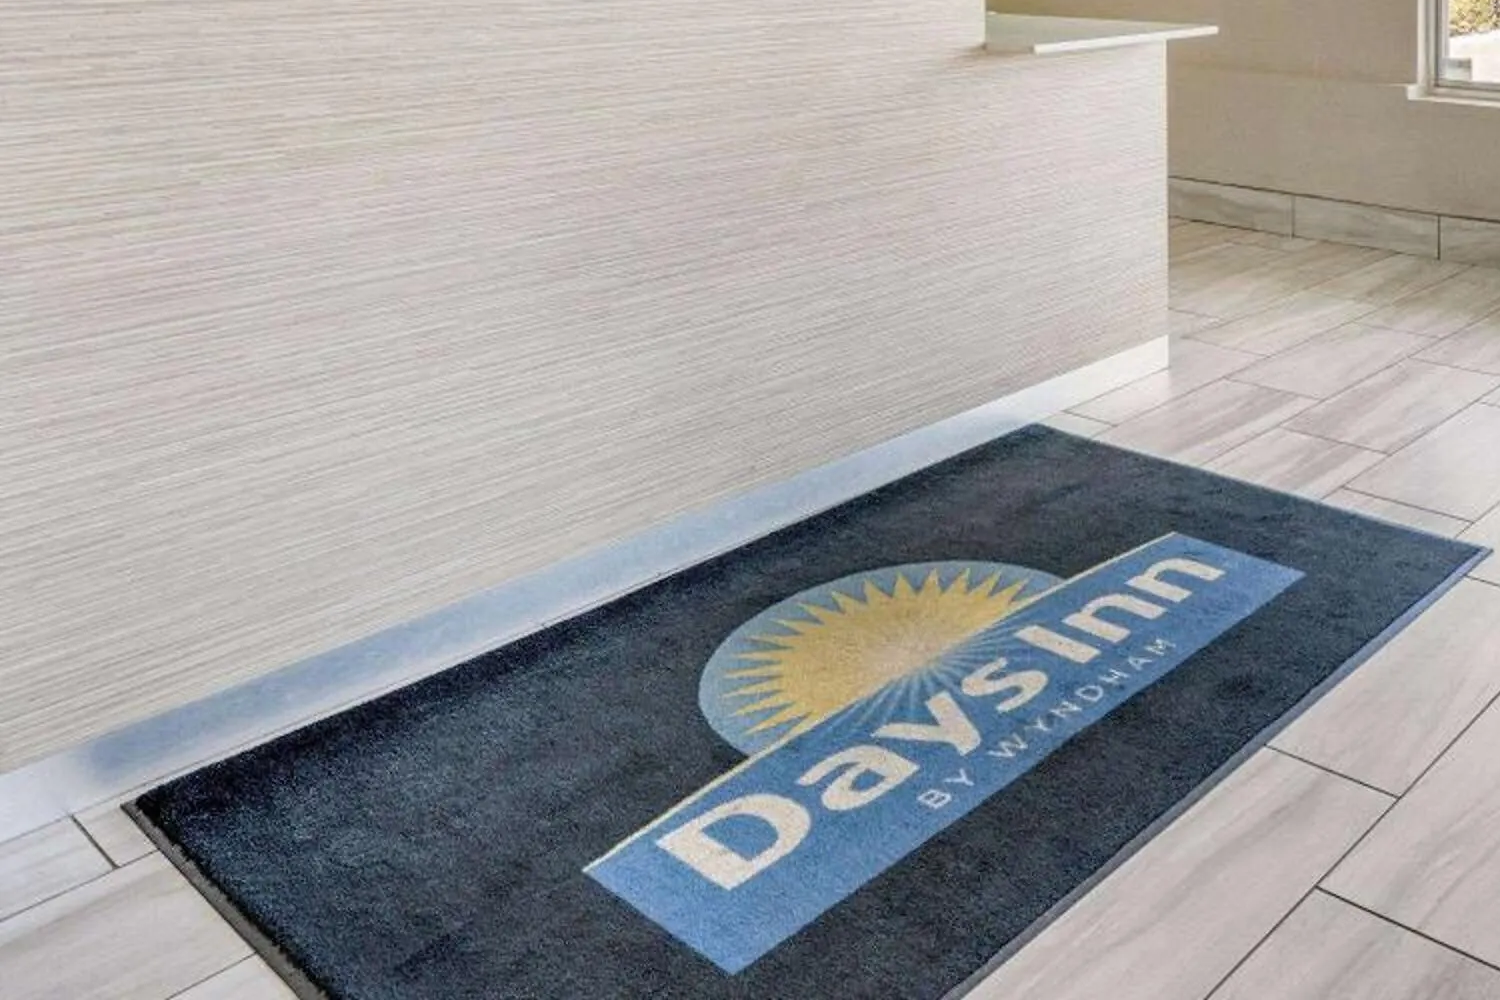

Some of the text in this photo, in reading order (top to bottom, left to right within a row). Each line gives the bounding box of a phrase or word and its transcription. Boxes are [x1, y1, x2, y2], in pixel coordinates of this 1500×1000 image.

[654, 555, 1225, 891] Days Inn
[917, 637, 1177, 810] BY WYNDHAM
